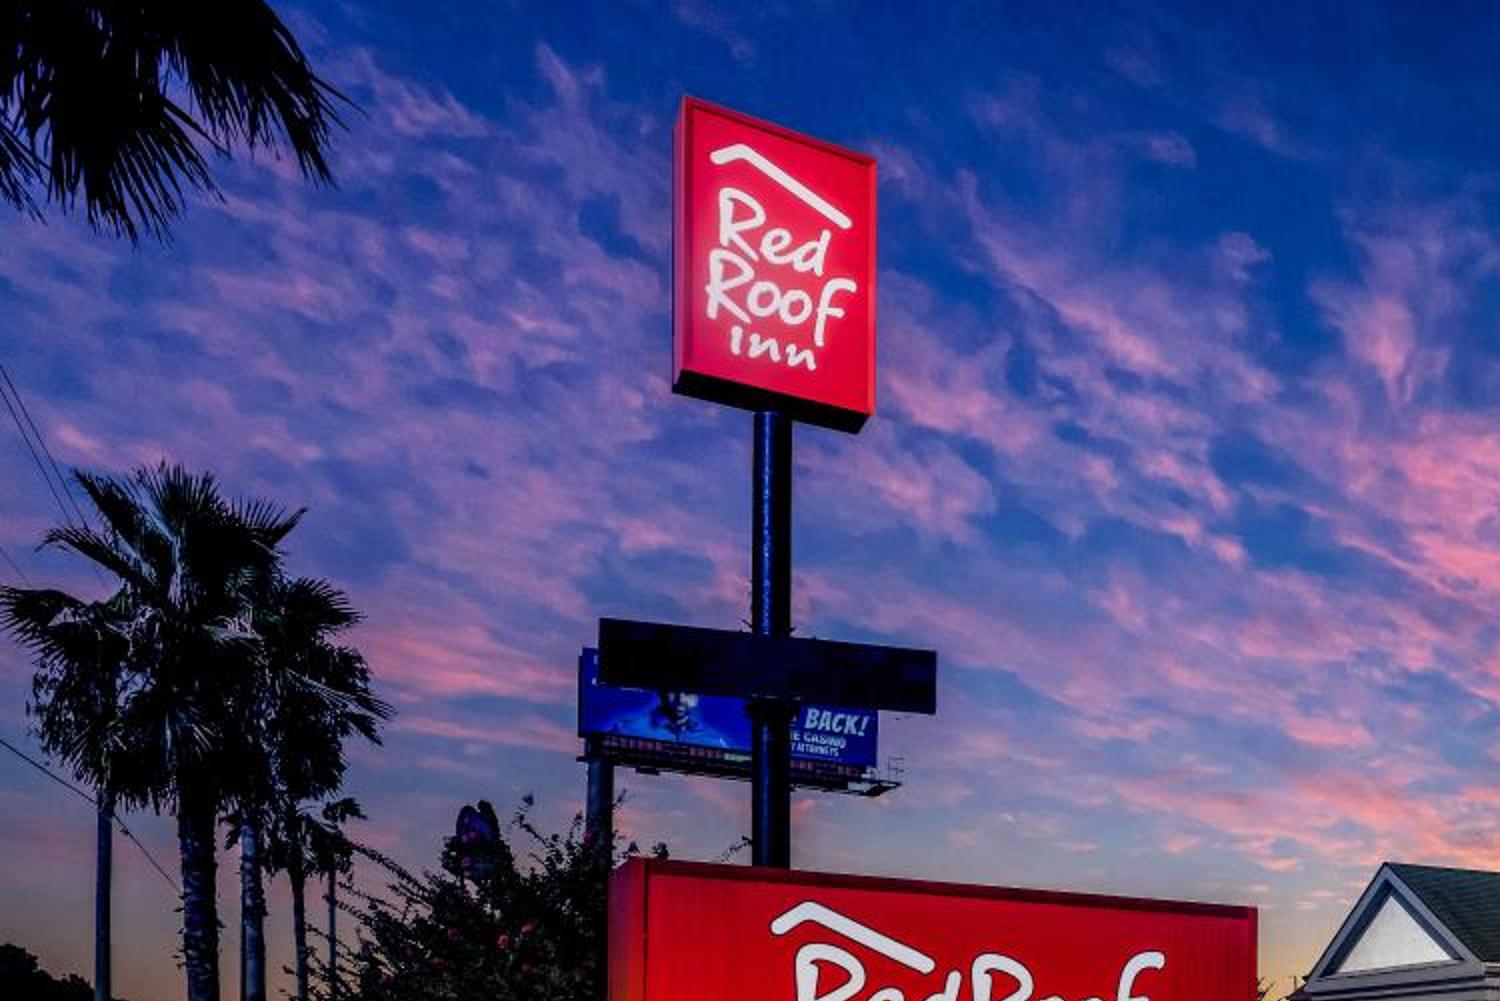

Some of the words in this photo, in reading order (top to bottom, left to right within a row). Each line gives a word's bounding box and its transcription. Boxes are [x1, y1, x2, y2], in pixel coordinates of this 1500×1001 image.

[718, 187, 831, 277] Red
[705, 248, 857, 347] Roof
[804, 707, 870, 737] BACK!
